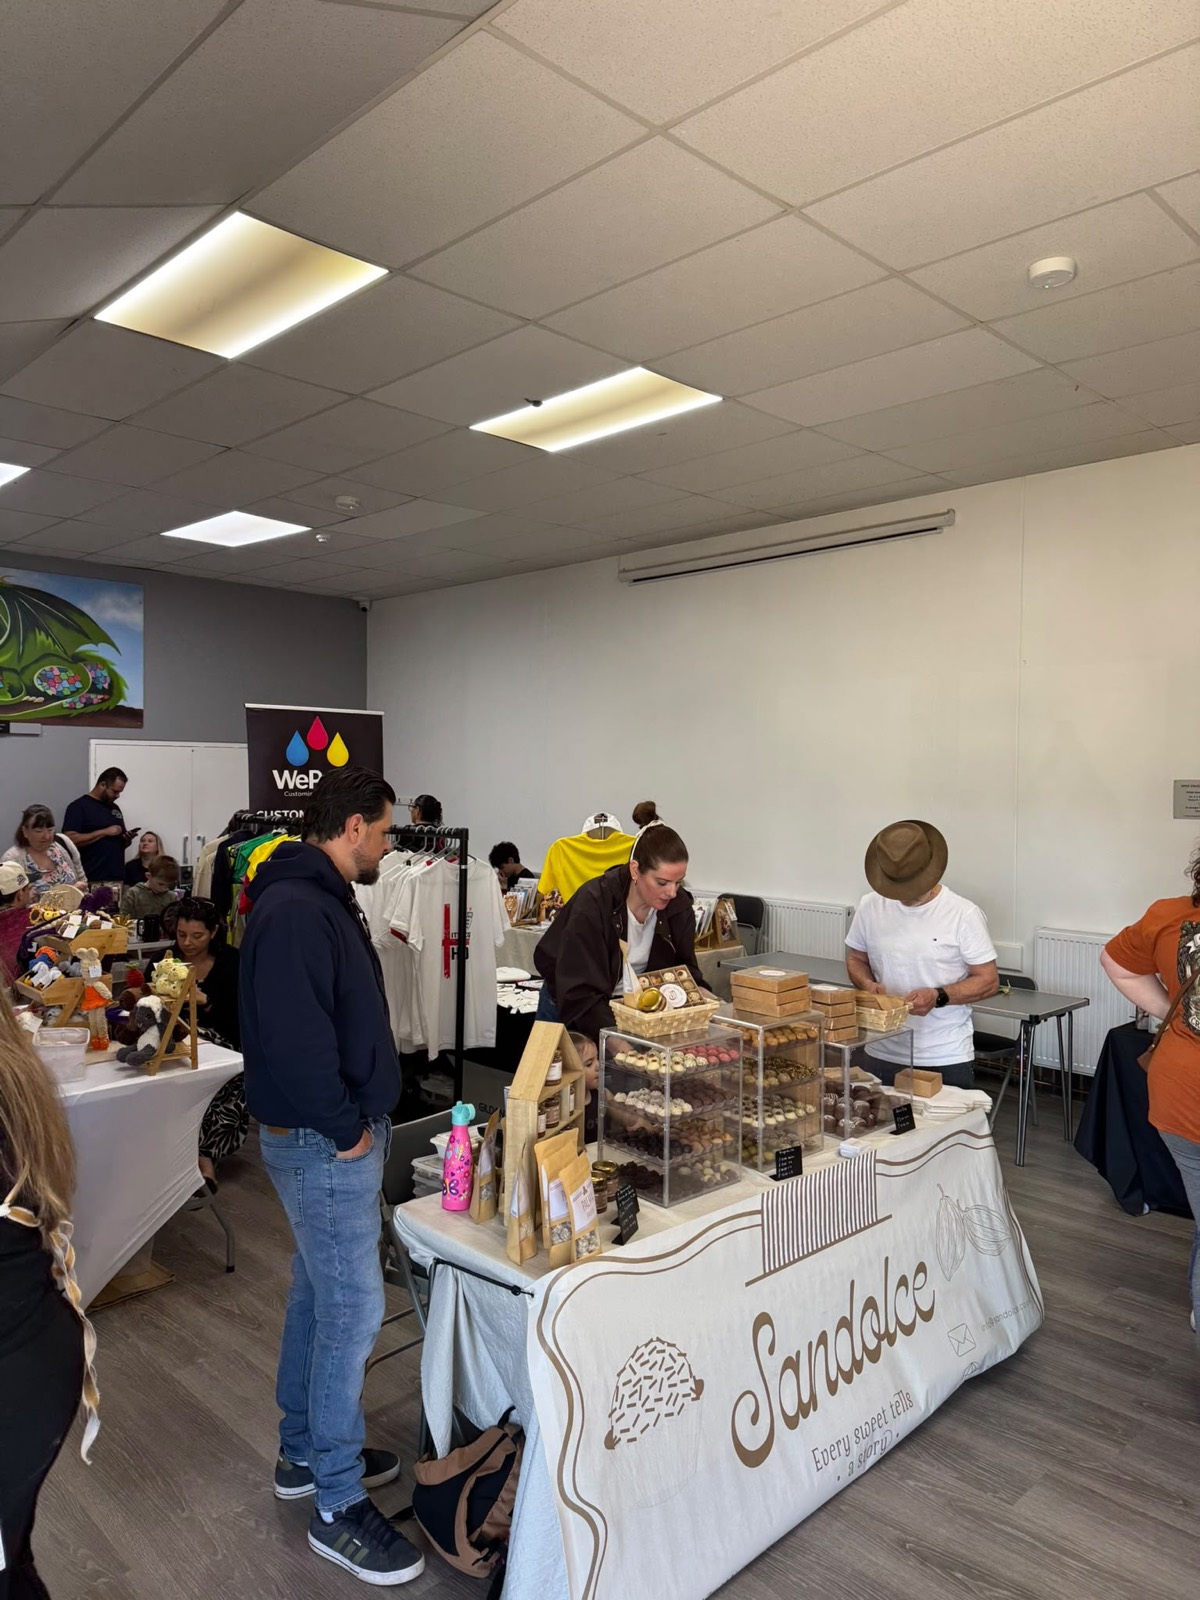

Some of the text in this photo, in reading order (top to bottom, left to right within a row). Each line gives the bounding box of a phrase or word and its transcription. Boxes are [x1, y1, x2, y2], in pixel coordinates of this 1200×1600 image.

[272, 769, 323, 790] WeP
[731, 1256, 935, 1468] Sandolce
[811, 1389, 914, 1472] Every sweet tells
[848, 1429, 893, 1477] a story
